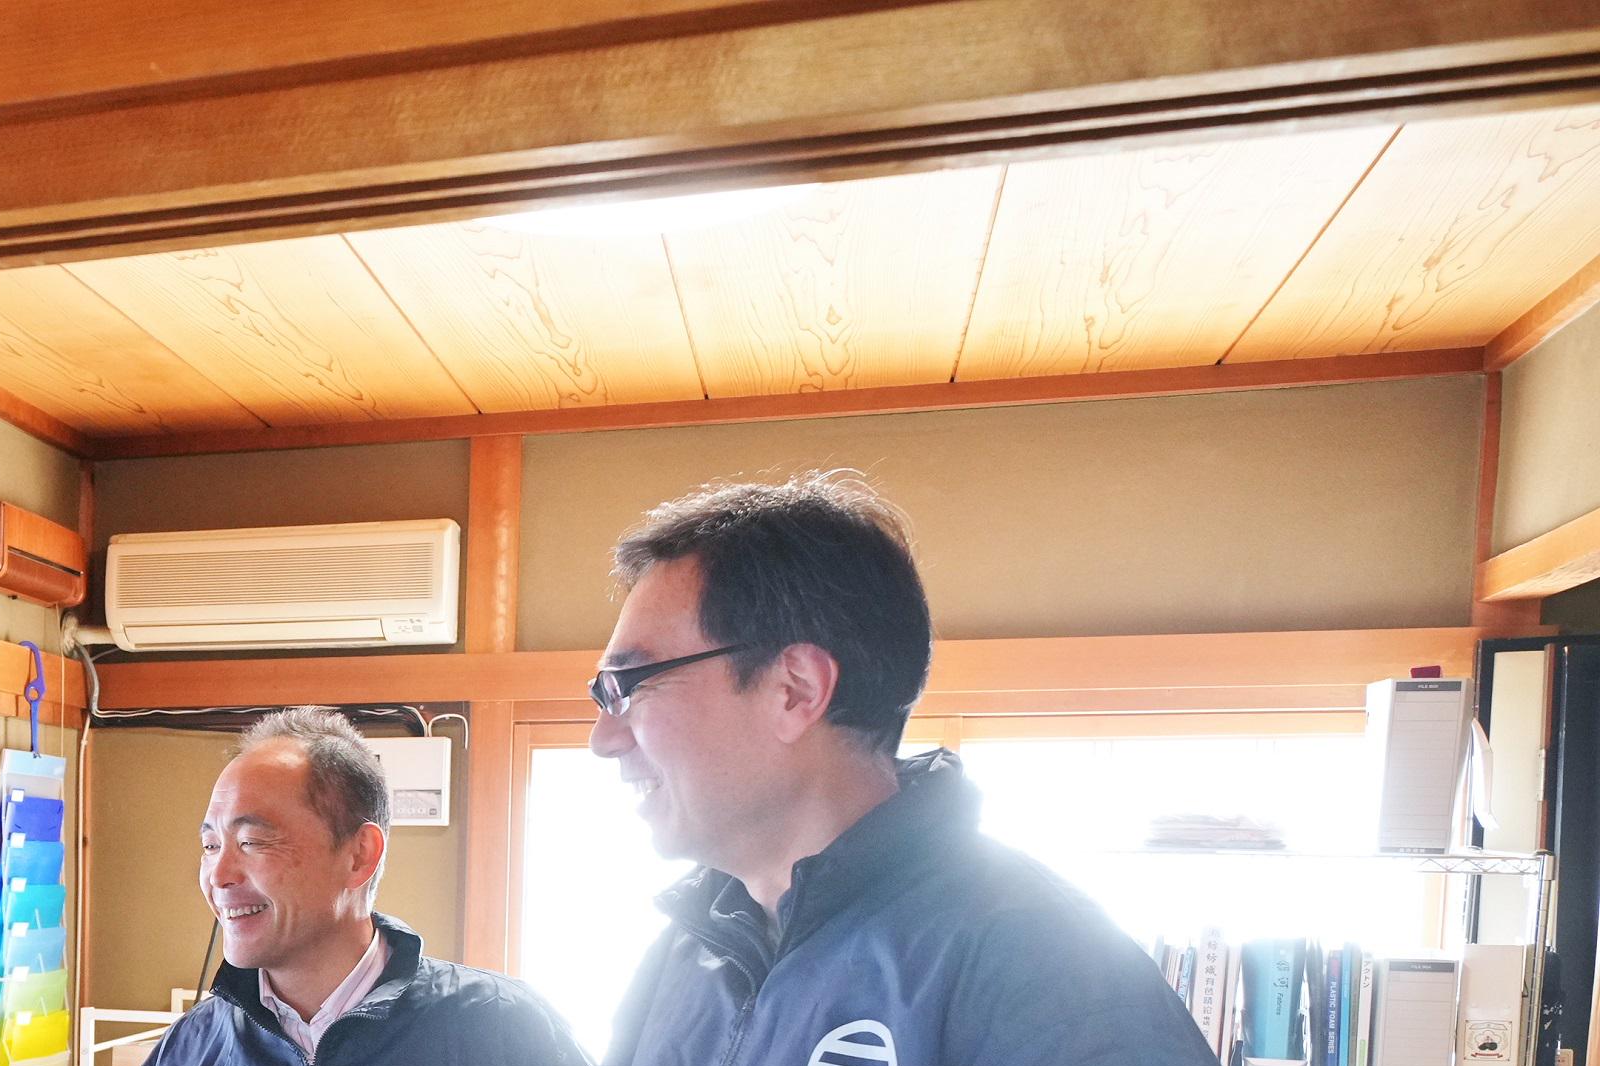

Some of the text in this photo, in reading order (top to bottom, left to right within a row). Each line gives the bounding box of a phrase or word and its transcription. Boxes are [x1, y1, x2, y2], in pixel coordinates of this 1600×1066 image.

[1327, 981, 1337, 1055] PLASTIC FOAM SERIES
